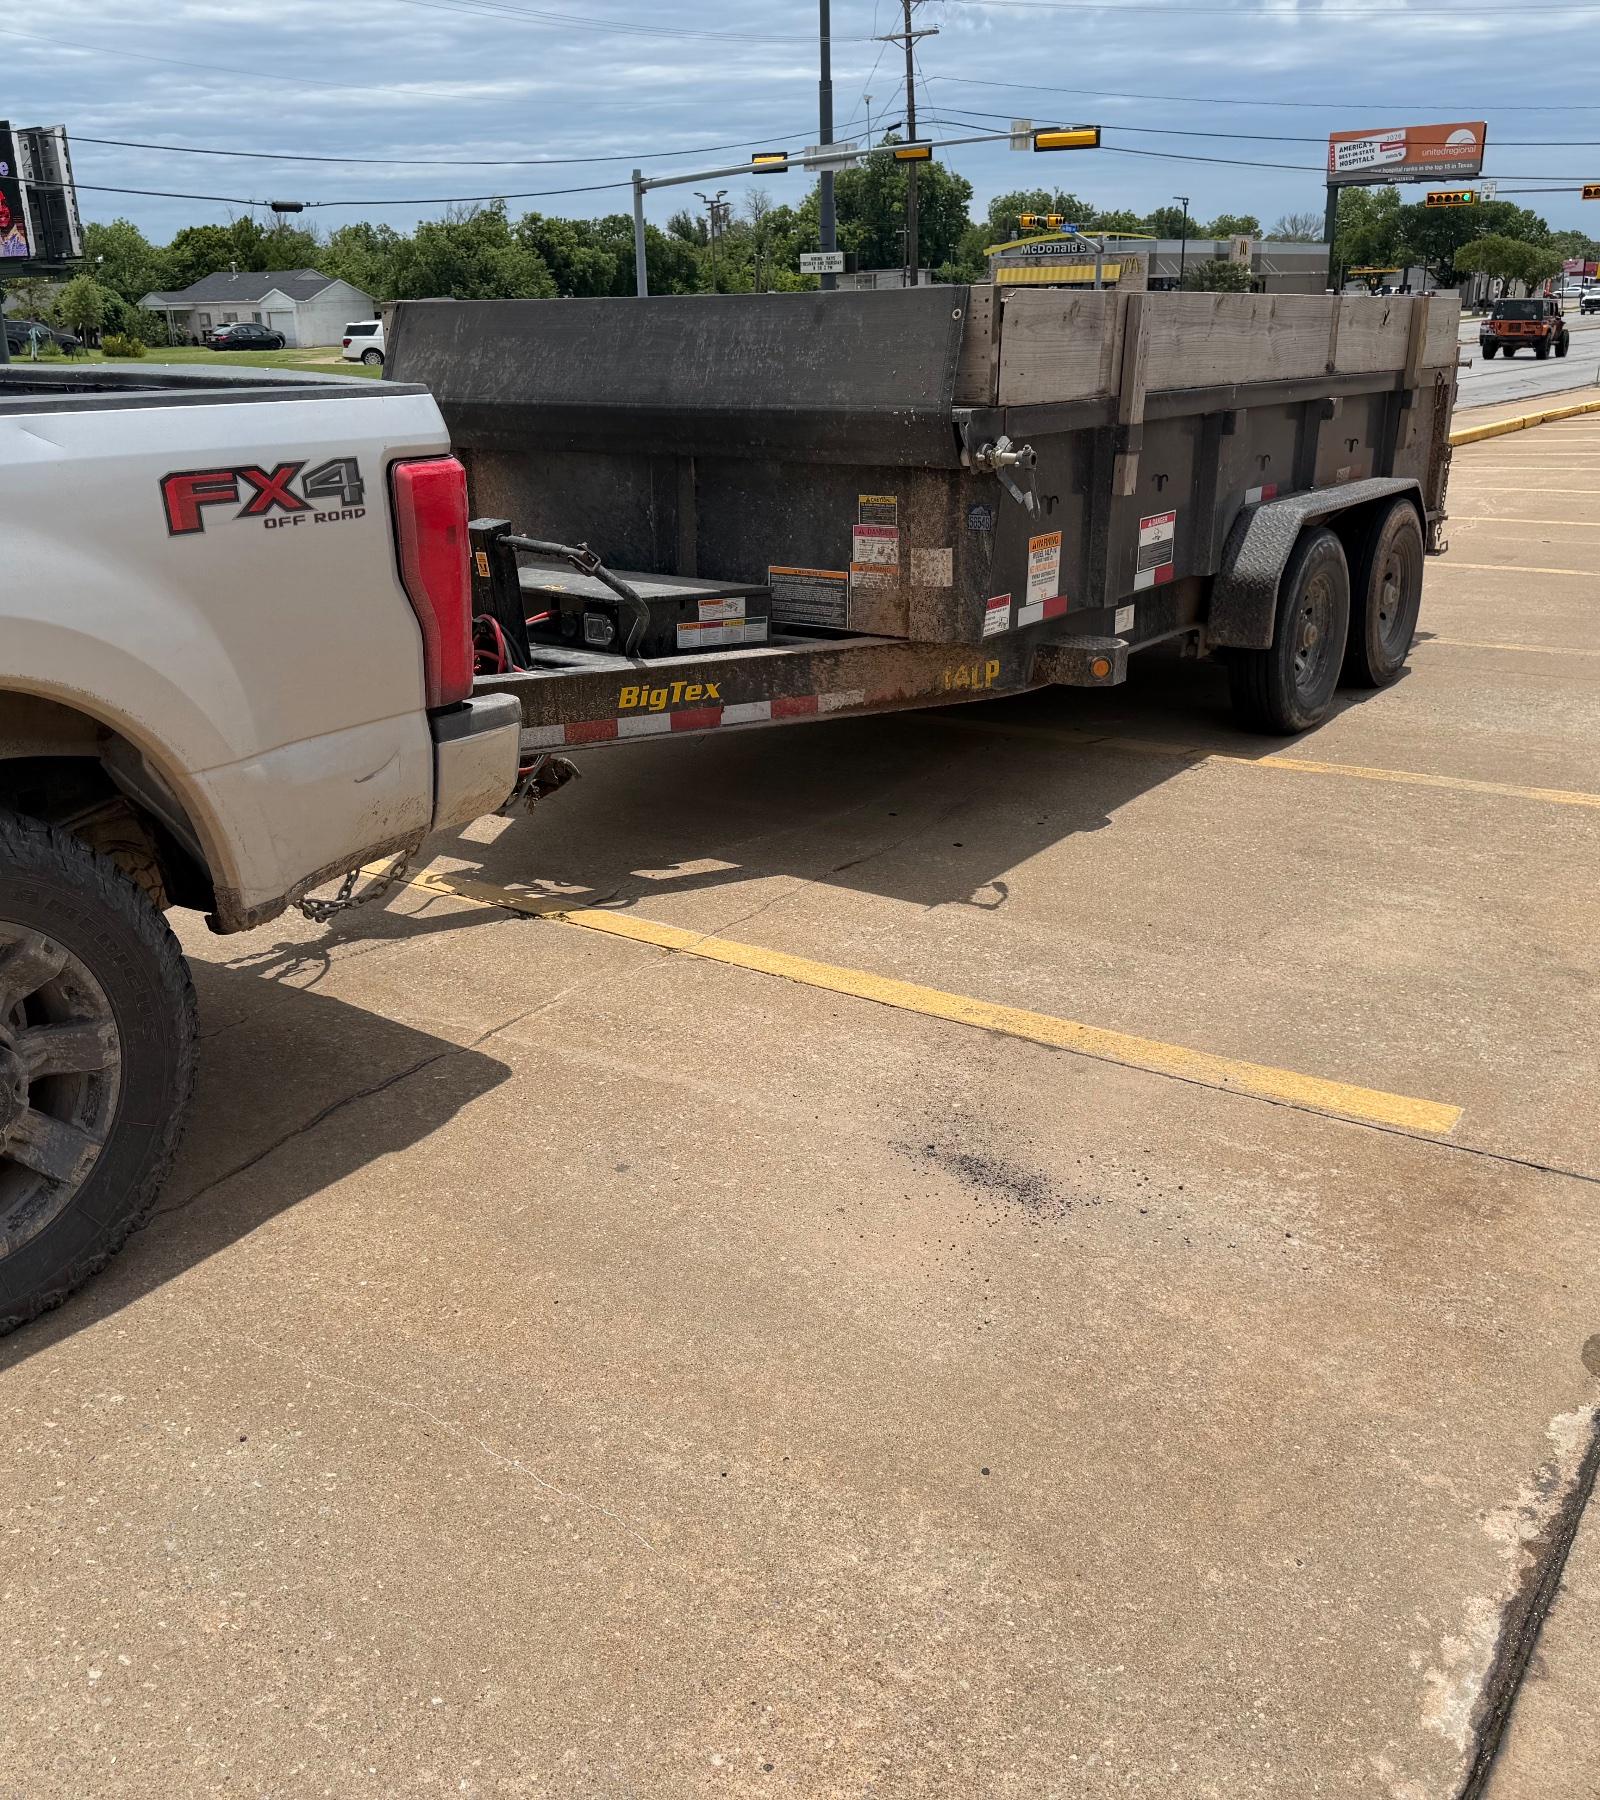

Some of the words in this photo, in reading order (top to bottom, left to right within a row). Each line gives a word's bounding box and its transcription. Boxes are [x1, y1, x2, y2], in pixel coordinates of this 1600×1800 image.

[1339, 141, 1373, 153] AMERICA'S
[1422, 145, 1476, 156] unitedregional
[1338, 148, 1376, 160] BEST-IN-STATE
[1339, 155, 1375, 167] HOSPITALS
[1020, 243, 1086, 255] McDonald's
[159, 456, 365, 538] FX4
[264, 514, 306, 529] OFF
[314, 508, 366, 524] ROAD
[618, 680, 721, 711] BigTex
